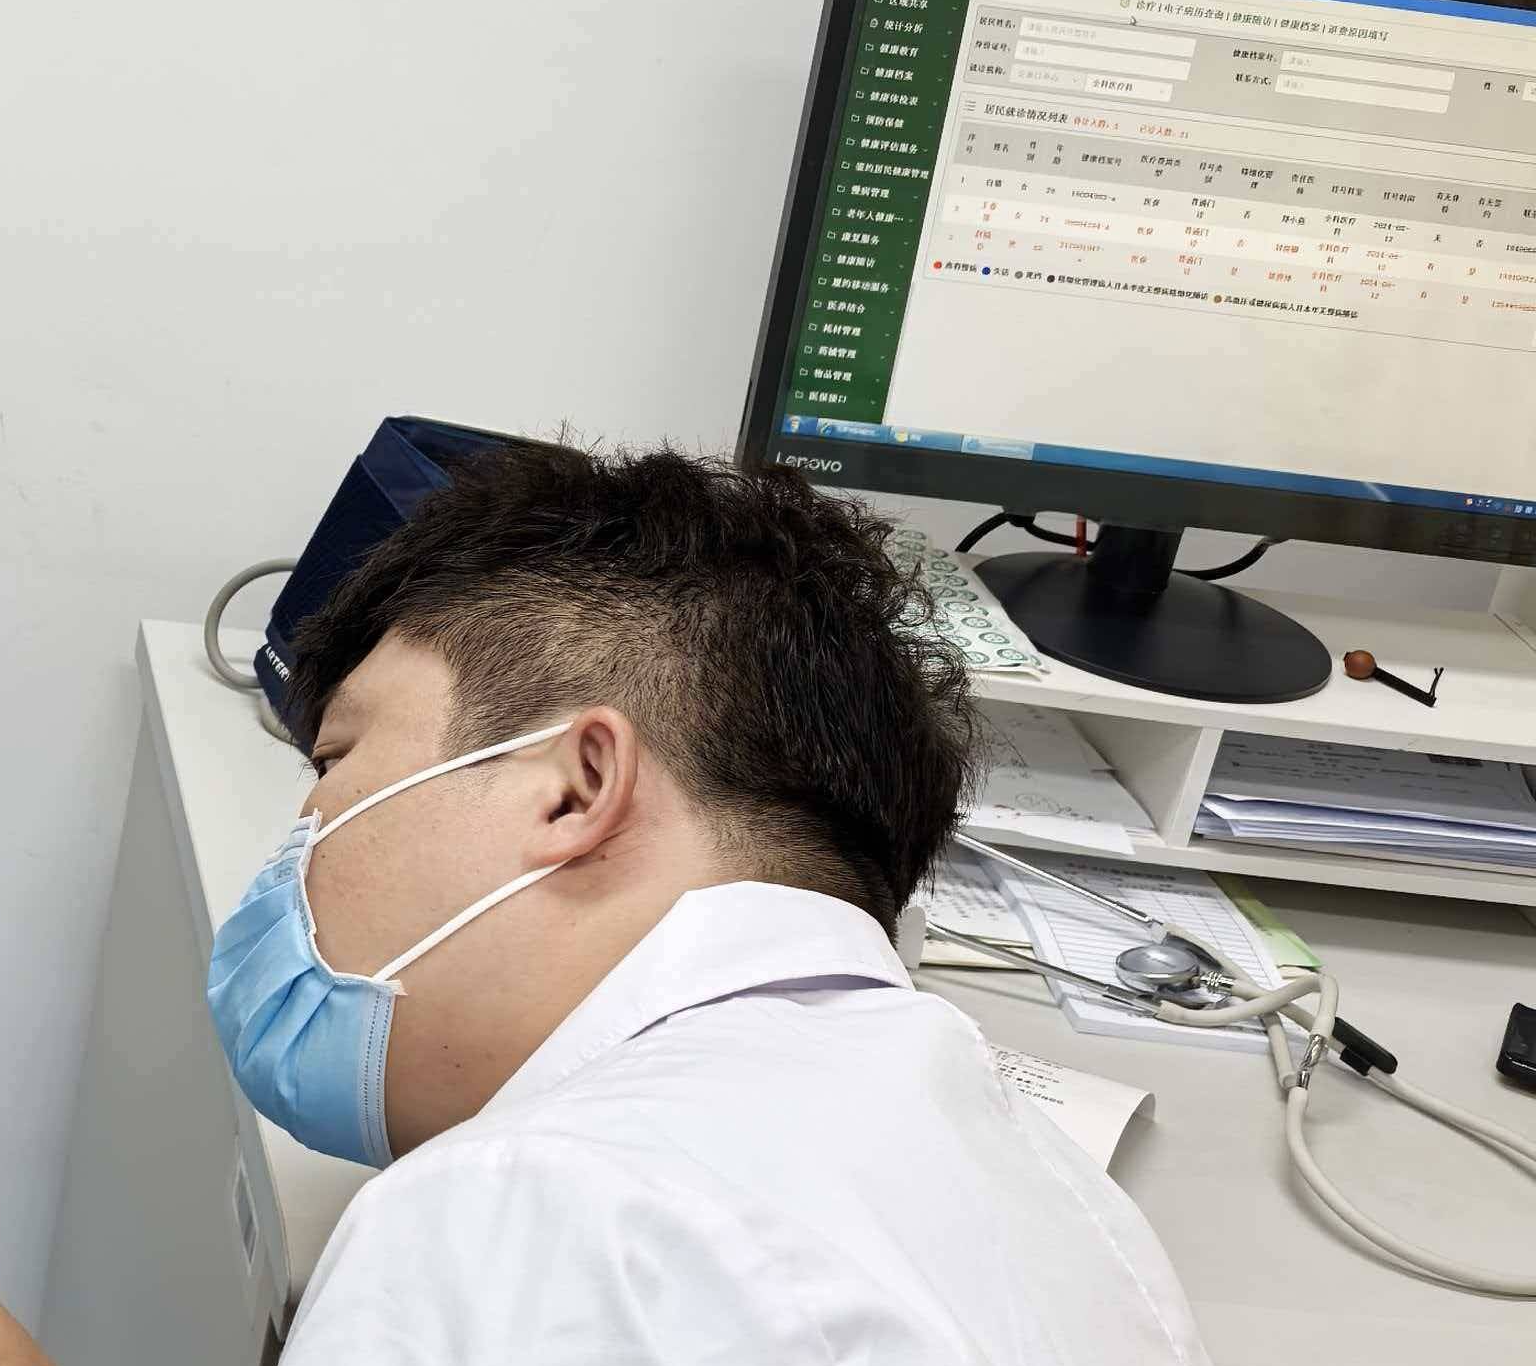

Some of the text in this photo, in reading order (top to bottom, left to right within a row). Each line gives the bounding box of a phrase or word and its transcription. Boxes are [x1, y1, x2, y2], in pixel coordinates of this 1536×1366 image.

[883, 19, 923, 34] 统计分析
[878, 43, 918, 58] 健康教育
[874, 67, 914, 81] 健康档案
[869, 91, 918, 106] 健康体检表
[983, 102, 1069, 124] 居民就诊情况列表
[864, 115, 904, 129] 预防保健
[859, 138, 918, 155] 健康评估服务
[850, 185, 889, 199] 慢病管理
[840, 231, 880, 245] 康复服务
[836, 254, 875, 268] 健康随访
[826, 299, 865, 314] 医养结合
[822, 323, 861, 337] 耗材管理
[813, 368, 852, 382] 物品管理
[808, 390, 847, 405] 医保接口
[775, 451, 842, 473] Lenovo
